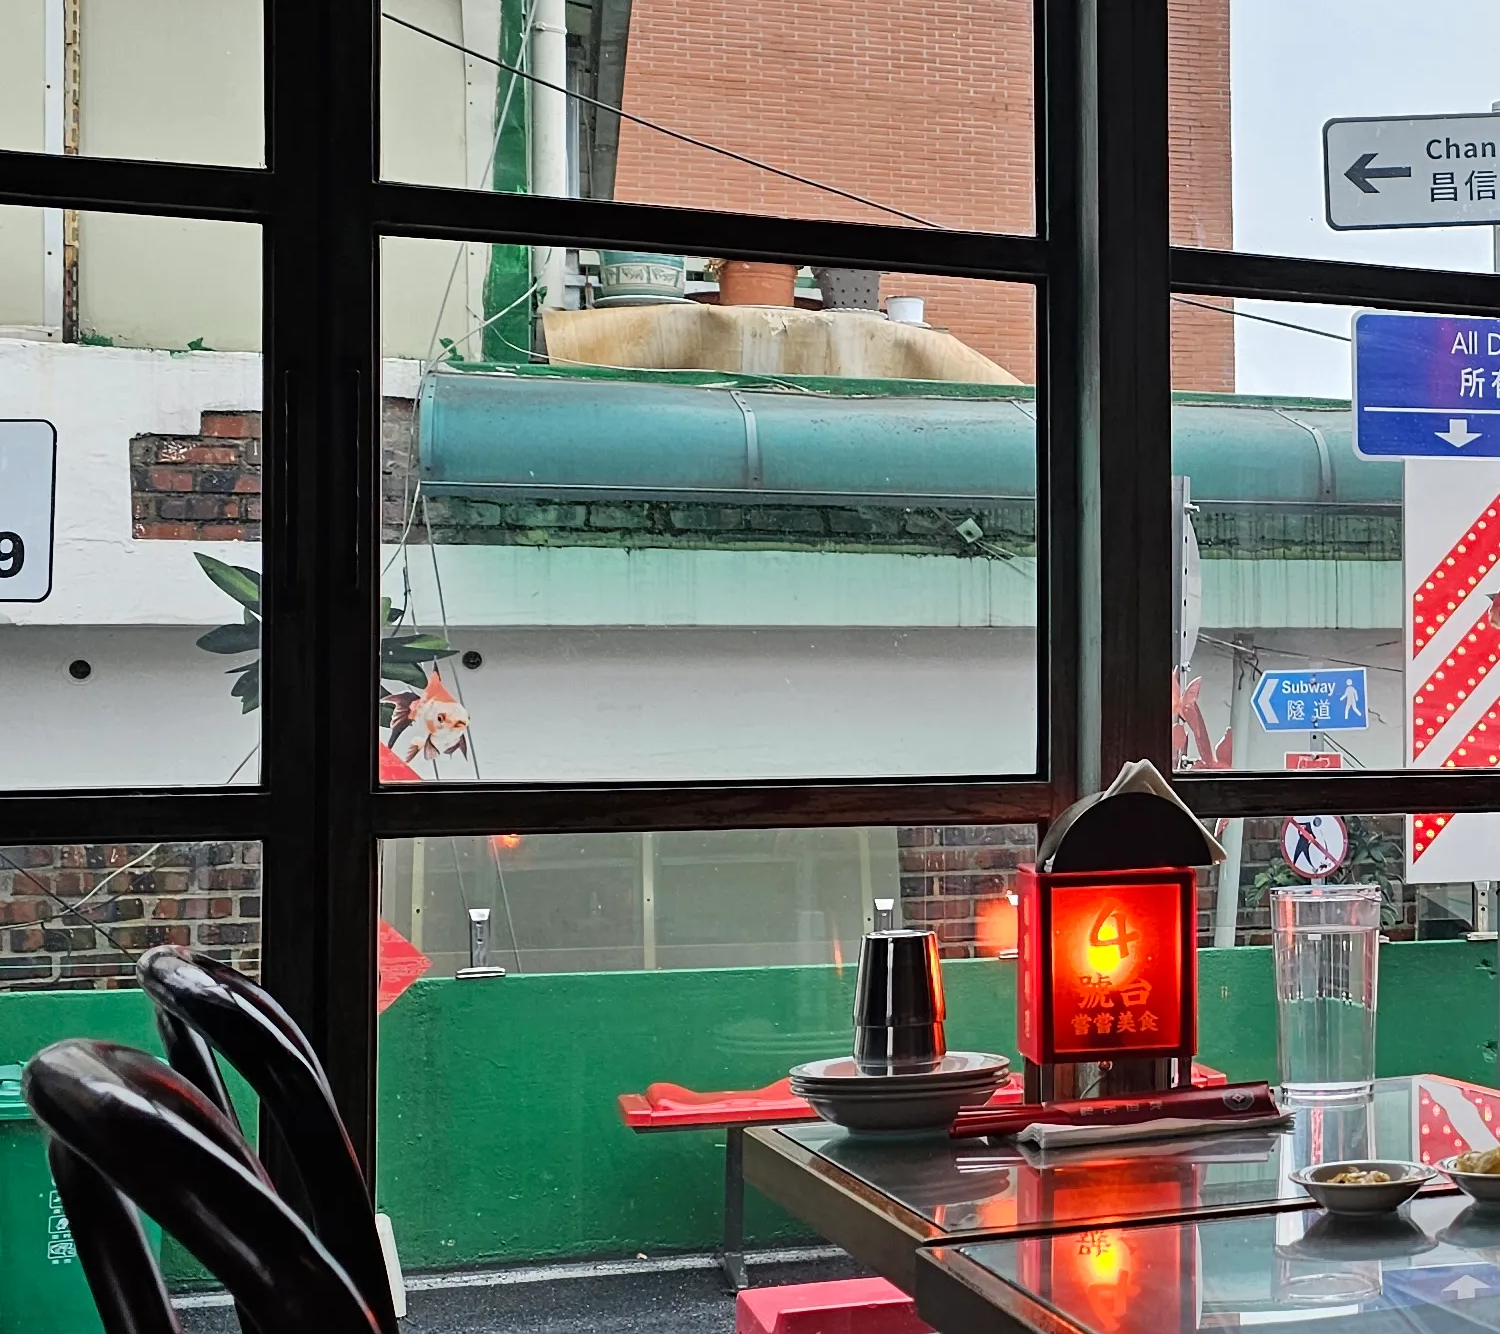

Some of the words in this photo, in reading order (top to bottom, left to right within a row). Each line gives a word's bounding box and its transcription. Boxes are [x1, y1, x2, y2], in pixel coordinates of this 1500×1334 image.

[1450, 330, 1478, 356] All
[1281, 679, 1336, 697] Subway
[1287, 698, 1332, 721] 隧道
[1088, 896, 1141, 960] 4
[1077, 972, 1153, 1009] 號台
